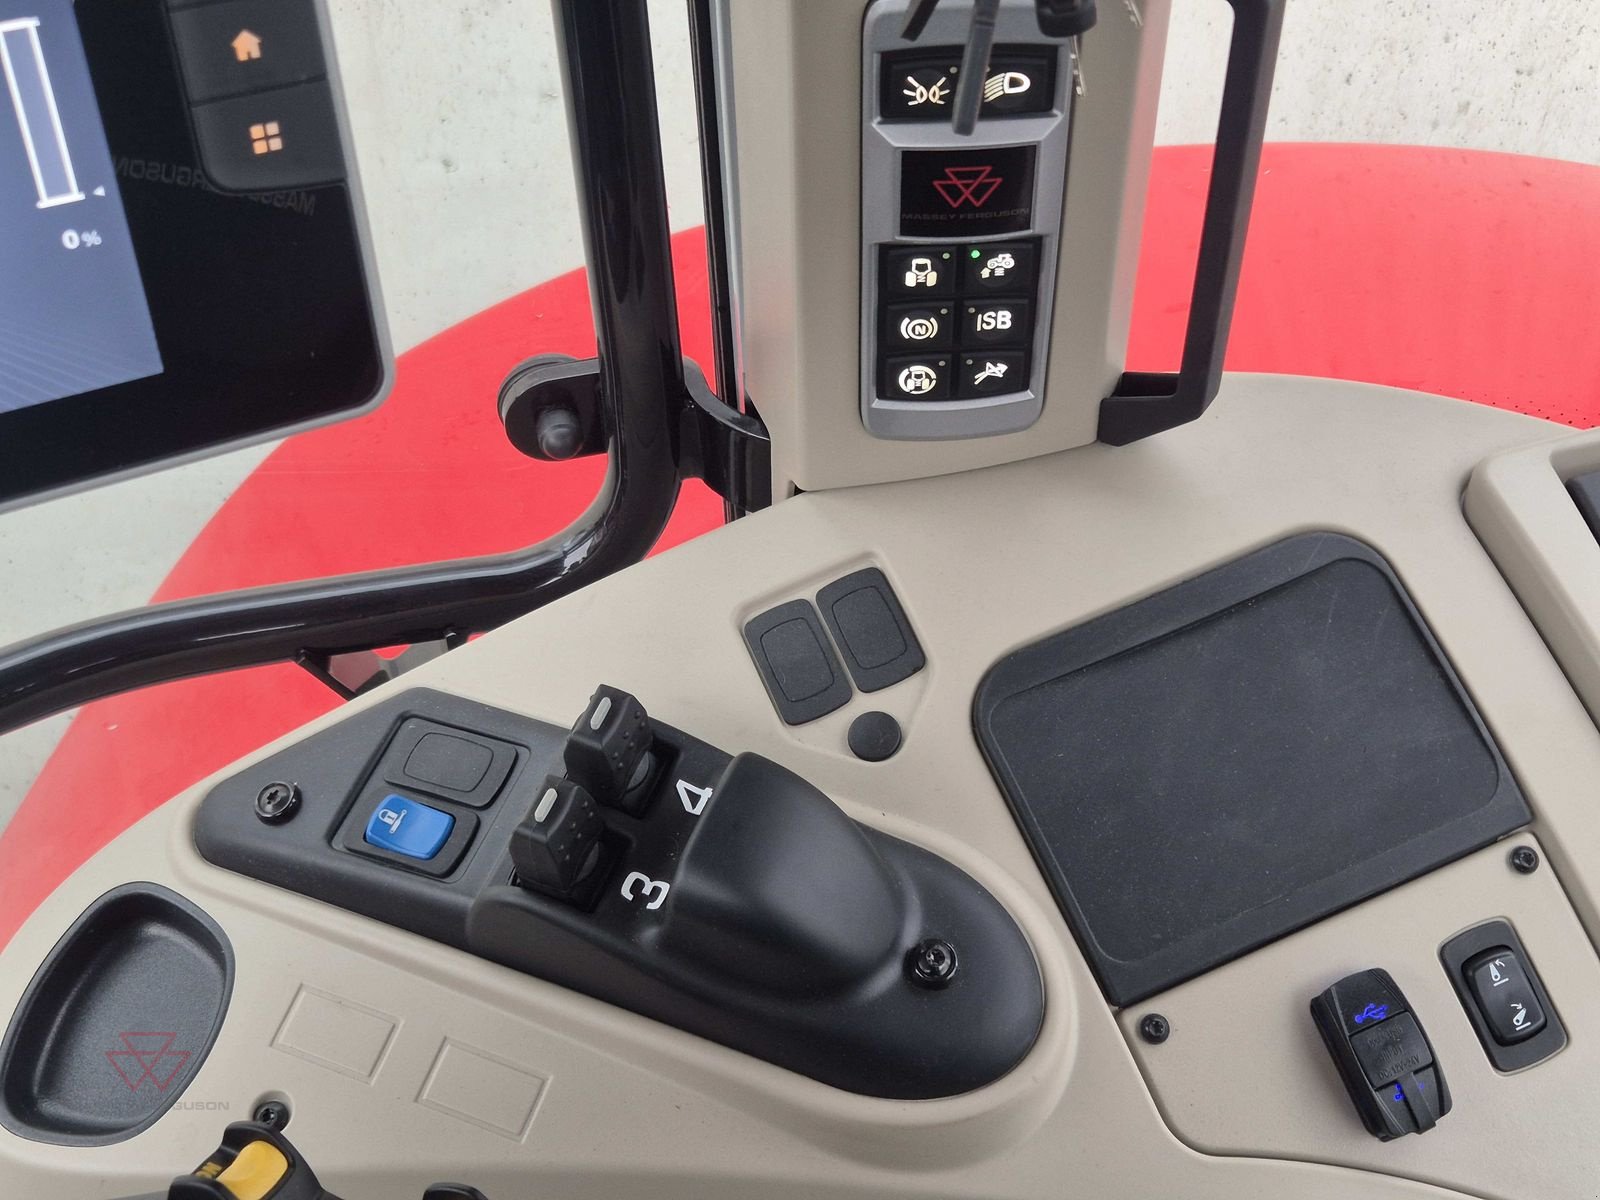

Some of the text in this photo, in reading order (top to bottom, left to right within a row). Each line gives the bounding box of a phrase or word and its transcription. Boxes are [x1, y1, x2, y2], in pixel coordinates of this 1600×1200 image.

[902, 207, 1029, 221] MASSEY FERGUSON
[976, 310, 1012, 332] ISB
[676, 779, 714, 816] 4
[620, 871, 671, 910] 3
